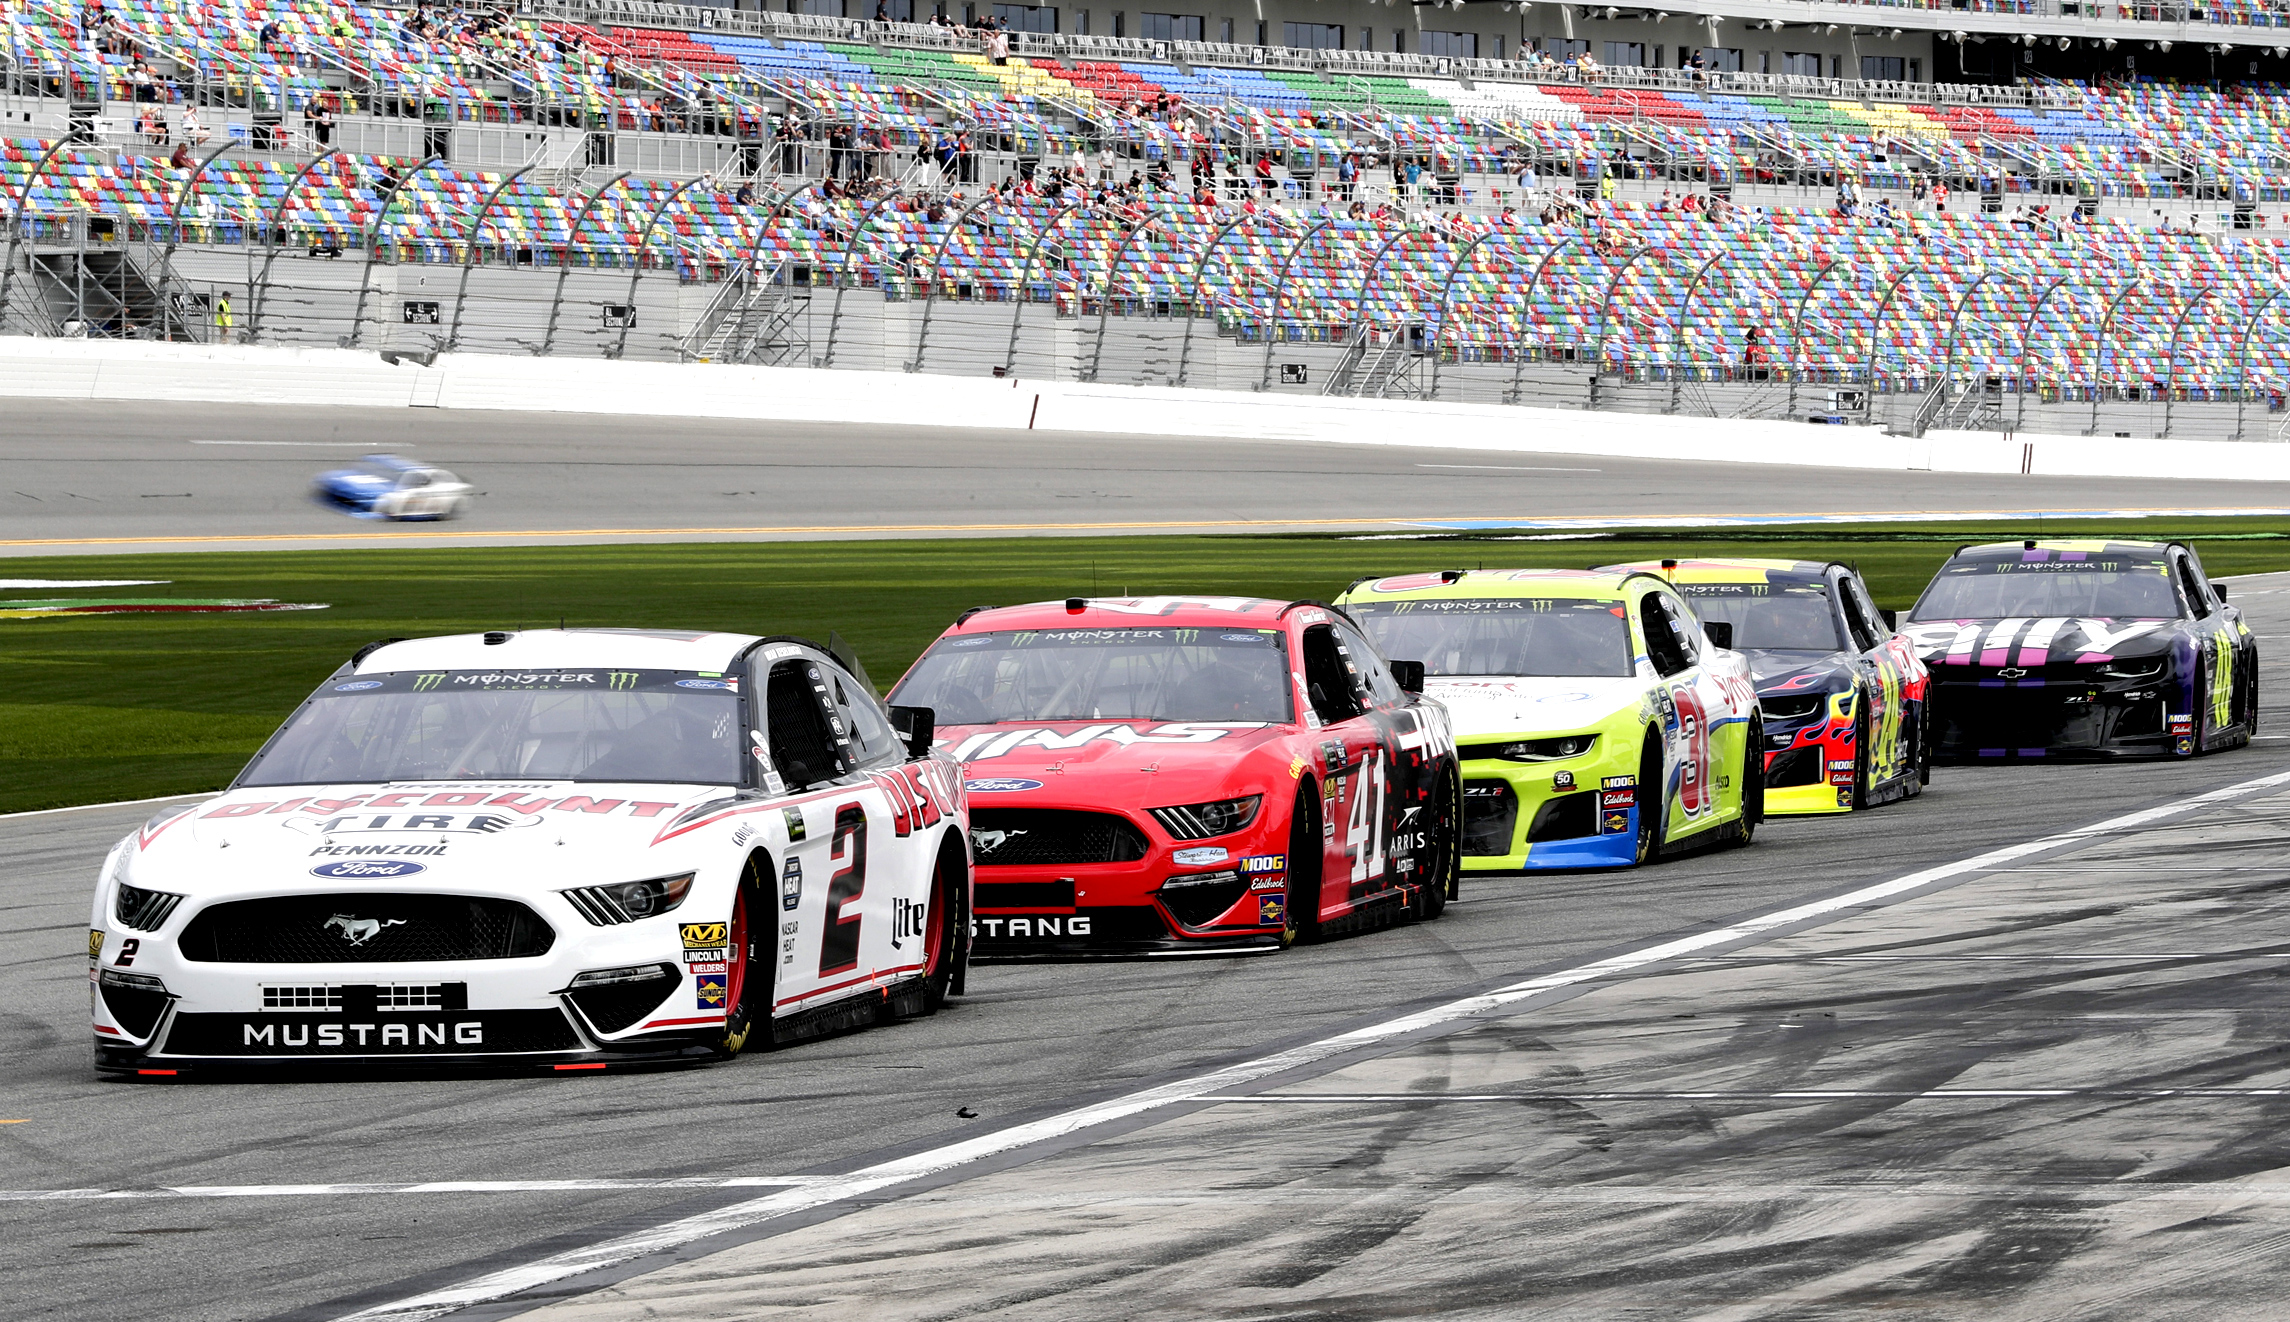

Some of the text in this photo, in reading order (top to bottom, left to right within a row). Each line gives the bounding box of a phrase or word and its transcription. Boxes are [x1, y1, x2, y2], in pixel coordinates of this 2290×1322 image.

[1828, 760, 1854, 770] MOOG
[965, 778, 1027, 791] Ford
[1603, 776, 1635, 789] MOOG
[198, 792, 679, 819] DISCOUNT
[322, 814, 514, 833] TIRE
[1346, 748, 1385, 884] 41
[1389, 831, 1426, 853] ARRIS
[308, 844, 448, 857] PENNZOIL
[1240, 855, 1285, 872] MOOG
[784, 876, 799, 896] HEAT
[818, 801, 868, 979] 2
[1250, 876, 1285, 891] Edelbrock
[782, 920, 799, 936] NASCAR
[114, 938, 140, 966] 2
[783, 938, 796, 952] HEAT
[684, 951, 721, 962] LINCOLN
[692, 964, 726, 973] WELDERS
[699, 988, 726, 998] SUNOCO
[243, 1022, 483, 1046] MUSTANG
